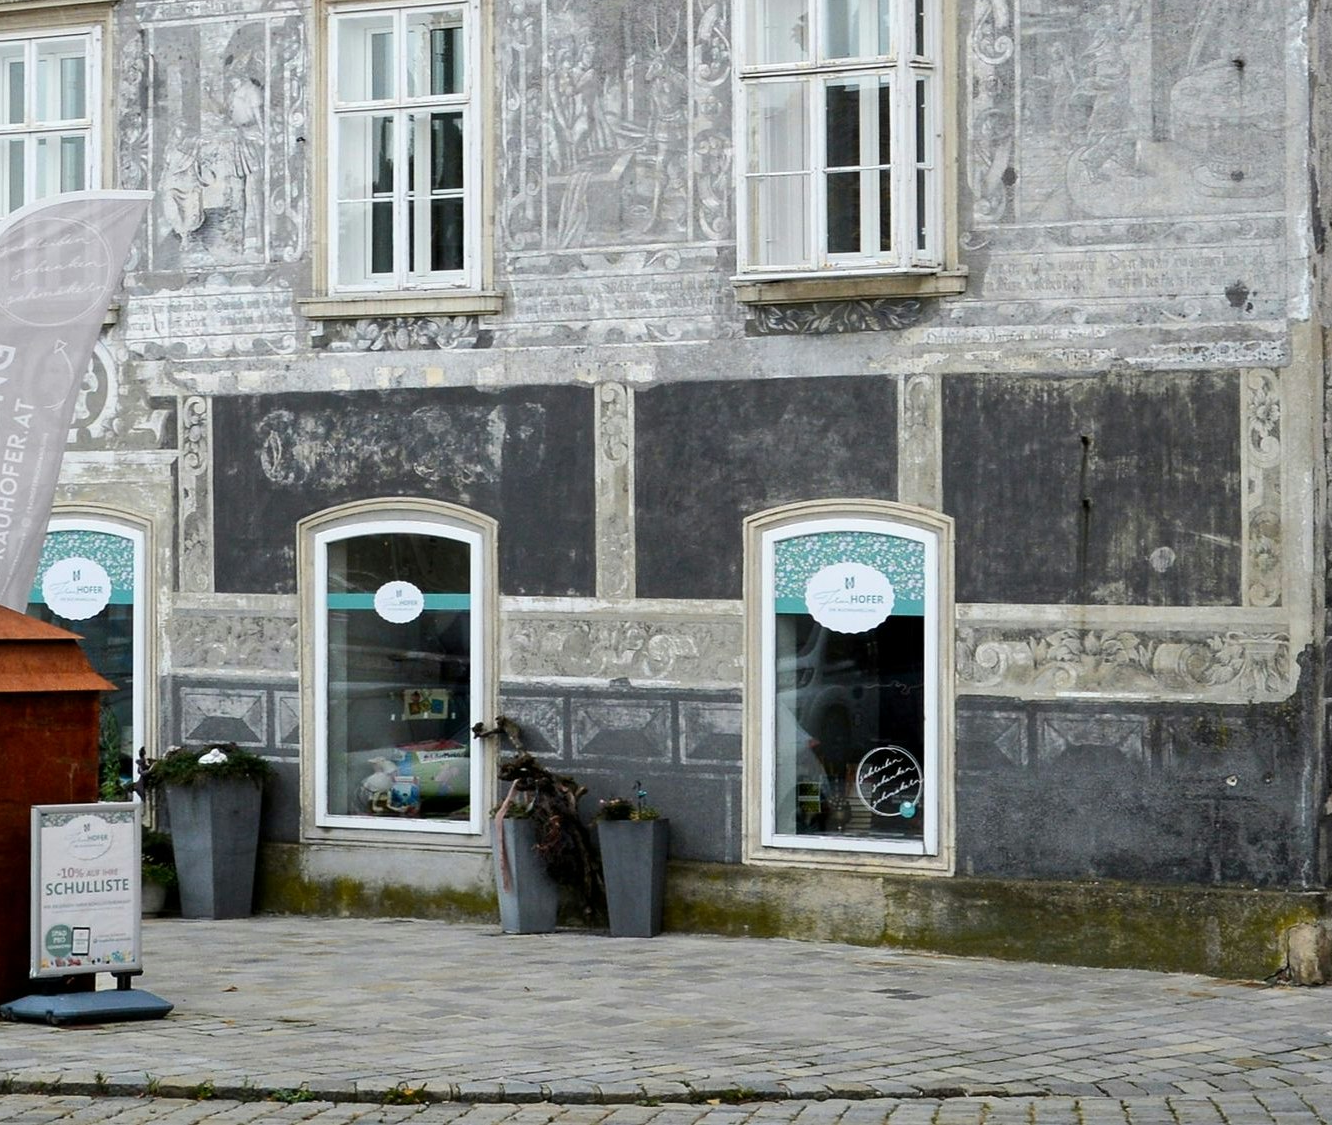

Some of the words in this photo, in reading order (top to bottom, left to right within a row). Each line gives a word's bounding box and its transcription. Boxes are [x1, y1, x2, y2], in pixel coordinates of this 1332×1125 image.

[77, 585, 103, 594] HOFER
[851, 595, 884, 604] HOFER
[57, 867, 85, 880] -10%
[86, 869, 100, 877] AUF
[102, 867, 119, 876] IHRE
[45, 878, 130, 896] SCHULLISTE
